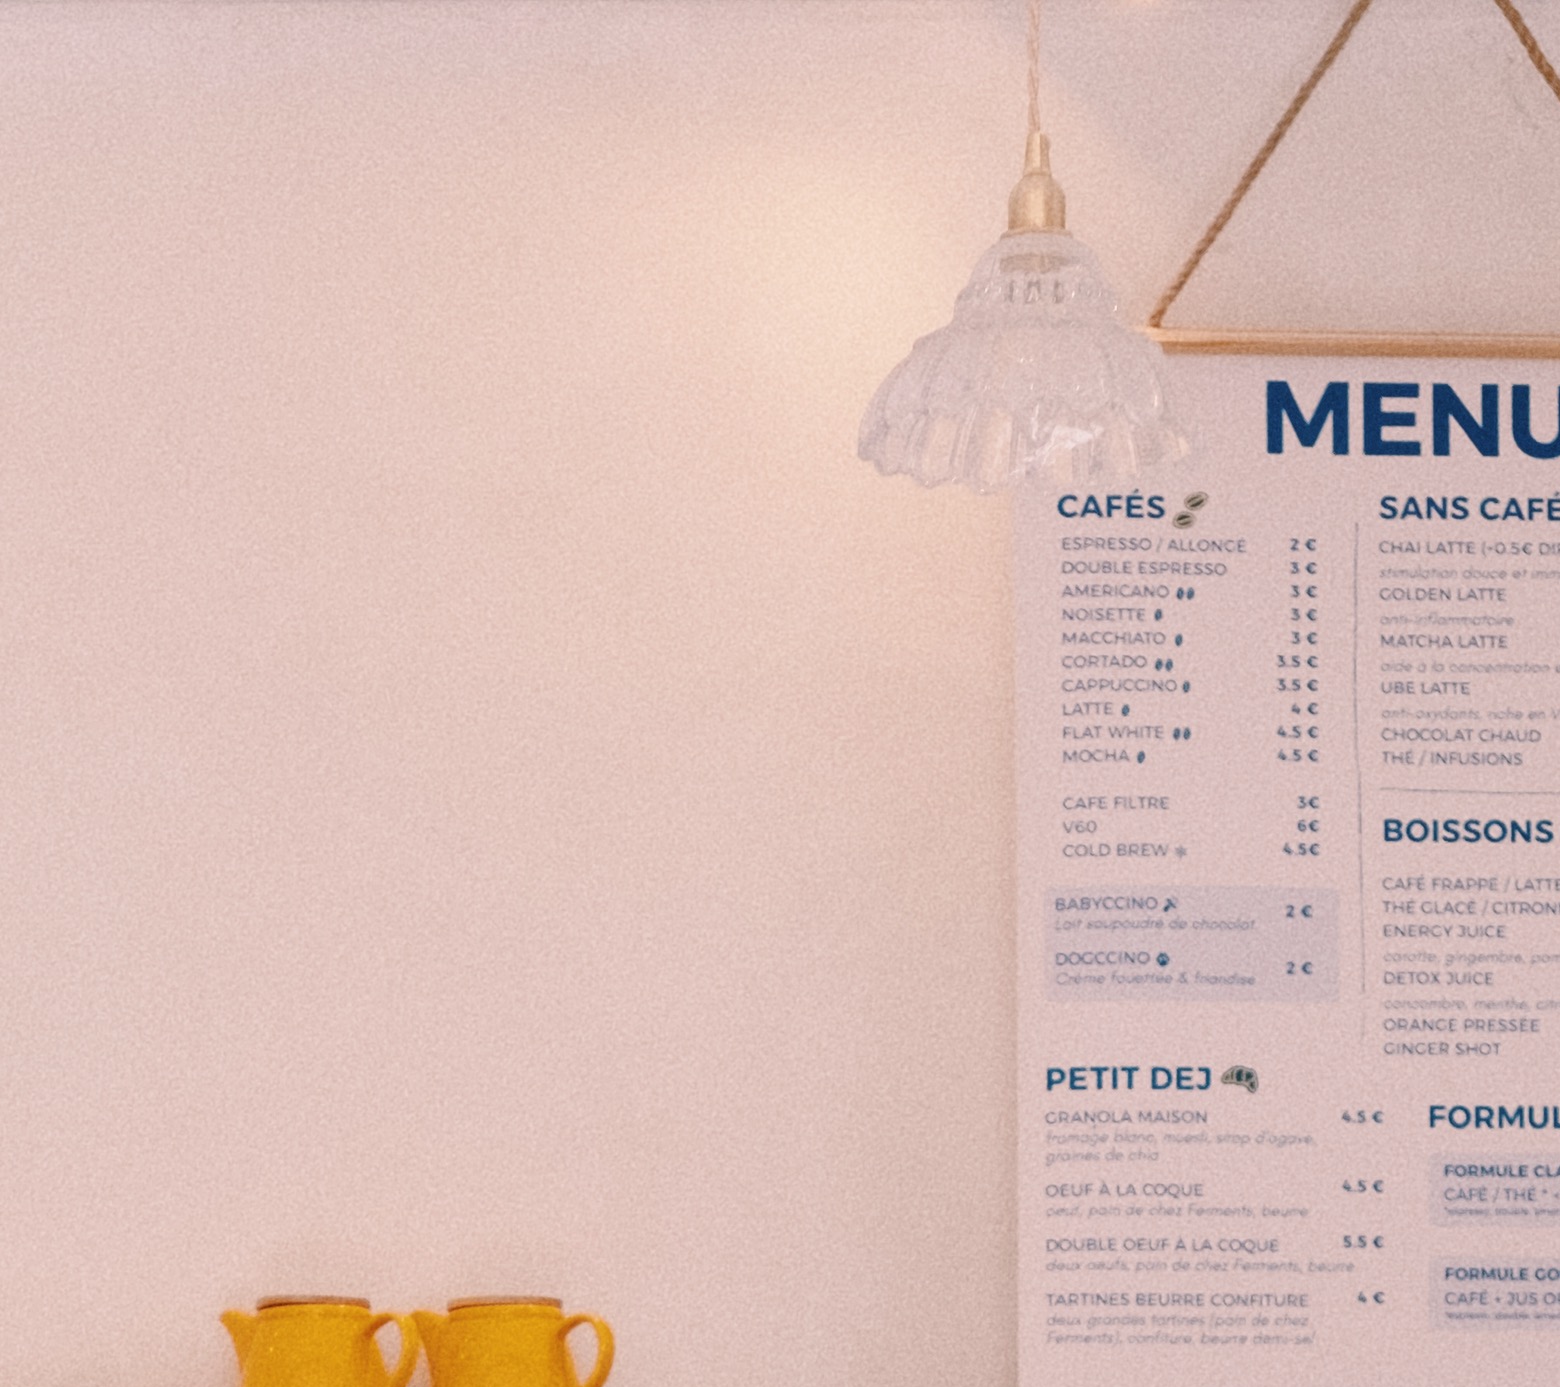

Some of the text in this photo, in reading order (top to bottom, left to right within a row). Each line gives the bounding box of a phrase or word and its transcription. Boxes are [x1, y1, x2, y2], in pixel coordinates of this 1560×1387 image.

[1057, 488, 1165, 519] CAFÉS
[1380, 496, 1469, 520] SANS
[1061, 537, 1152, 551] ESPRESSO
[1425, 540, 1476, 555] LATTE
[1061, 560, 1228, 576] DOUBLE ESPRESSO
[1061, 584, 1170, 598] AMERICANO
[1379, 587, 1506, 602] GOLDEN LATTE
[1061, 607, 1146, 622] NOISETTE
[1061, 631, 1166, 645] MACCHIATO
[1379, 634, 1508, 649] MATCHA LATTE
[1061, 655, 1148, 669] CORTADO
[1061, 678, 1178, 693] CAPPUCCINO
[1380, 681, 1470, 695] UBE LATTE
[1061, 701, 1114, 717] LATTE
[1061, 725, 1164, 740] FLAT WHITE
[1380, 727, 1542, 743] CHOCOLAT CHAUD
[1062, 749, 1130, 763] MOCHA
[1430, 751, 1523, 766] INFUSIONS
[1113, 795, 1169, 810] FILTRE
[1062, 820, 1098, 834] V60
[1383, 819, 1553, 843] BOISSONS
[1062, 843, 1169, 858] COLD BREW
[1054, 896, 1159, 911] BABYCCINO
[1382, 924, 1506, 939] ENERGY JUICE
[1383, 970, 1494, 986] DETOX JUICE
[1383, 1018, 1540, 1033] ORANGE PRESSÉE
[1383, 1042, 1500, 1056] GINGER SHOT
[1046, 1066, 1211, 1091] PETIT DEJ
[1044, 1110, 1208, 1125] GRANOLA MAISON
[1443, 1164, 1528, 1178] FORMULE
[1044, 1183, 1204, 1198] OEUF COQUE
[1045, 1237, 1279, 1254] DOUBLE OEUF COQUE
[1444, 1267, 1529, 1282] FORMULE
[1046, 1292, 1309, 1308] TARTINES BEURRE CONFITURE
